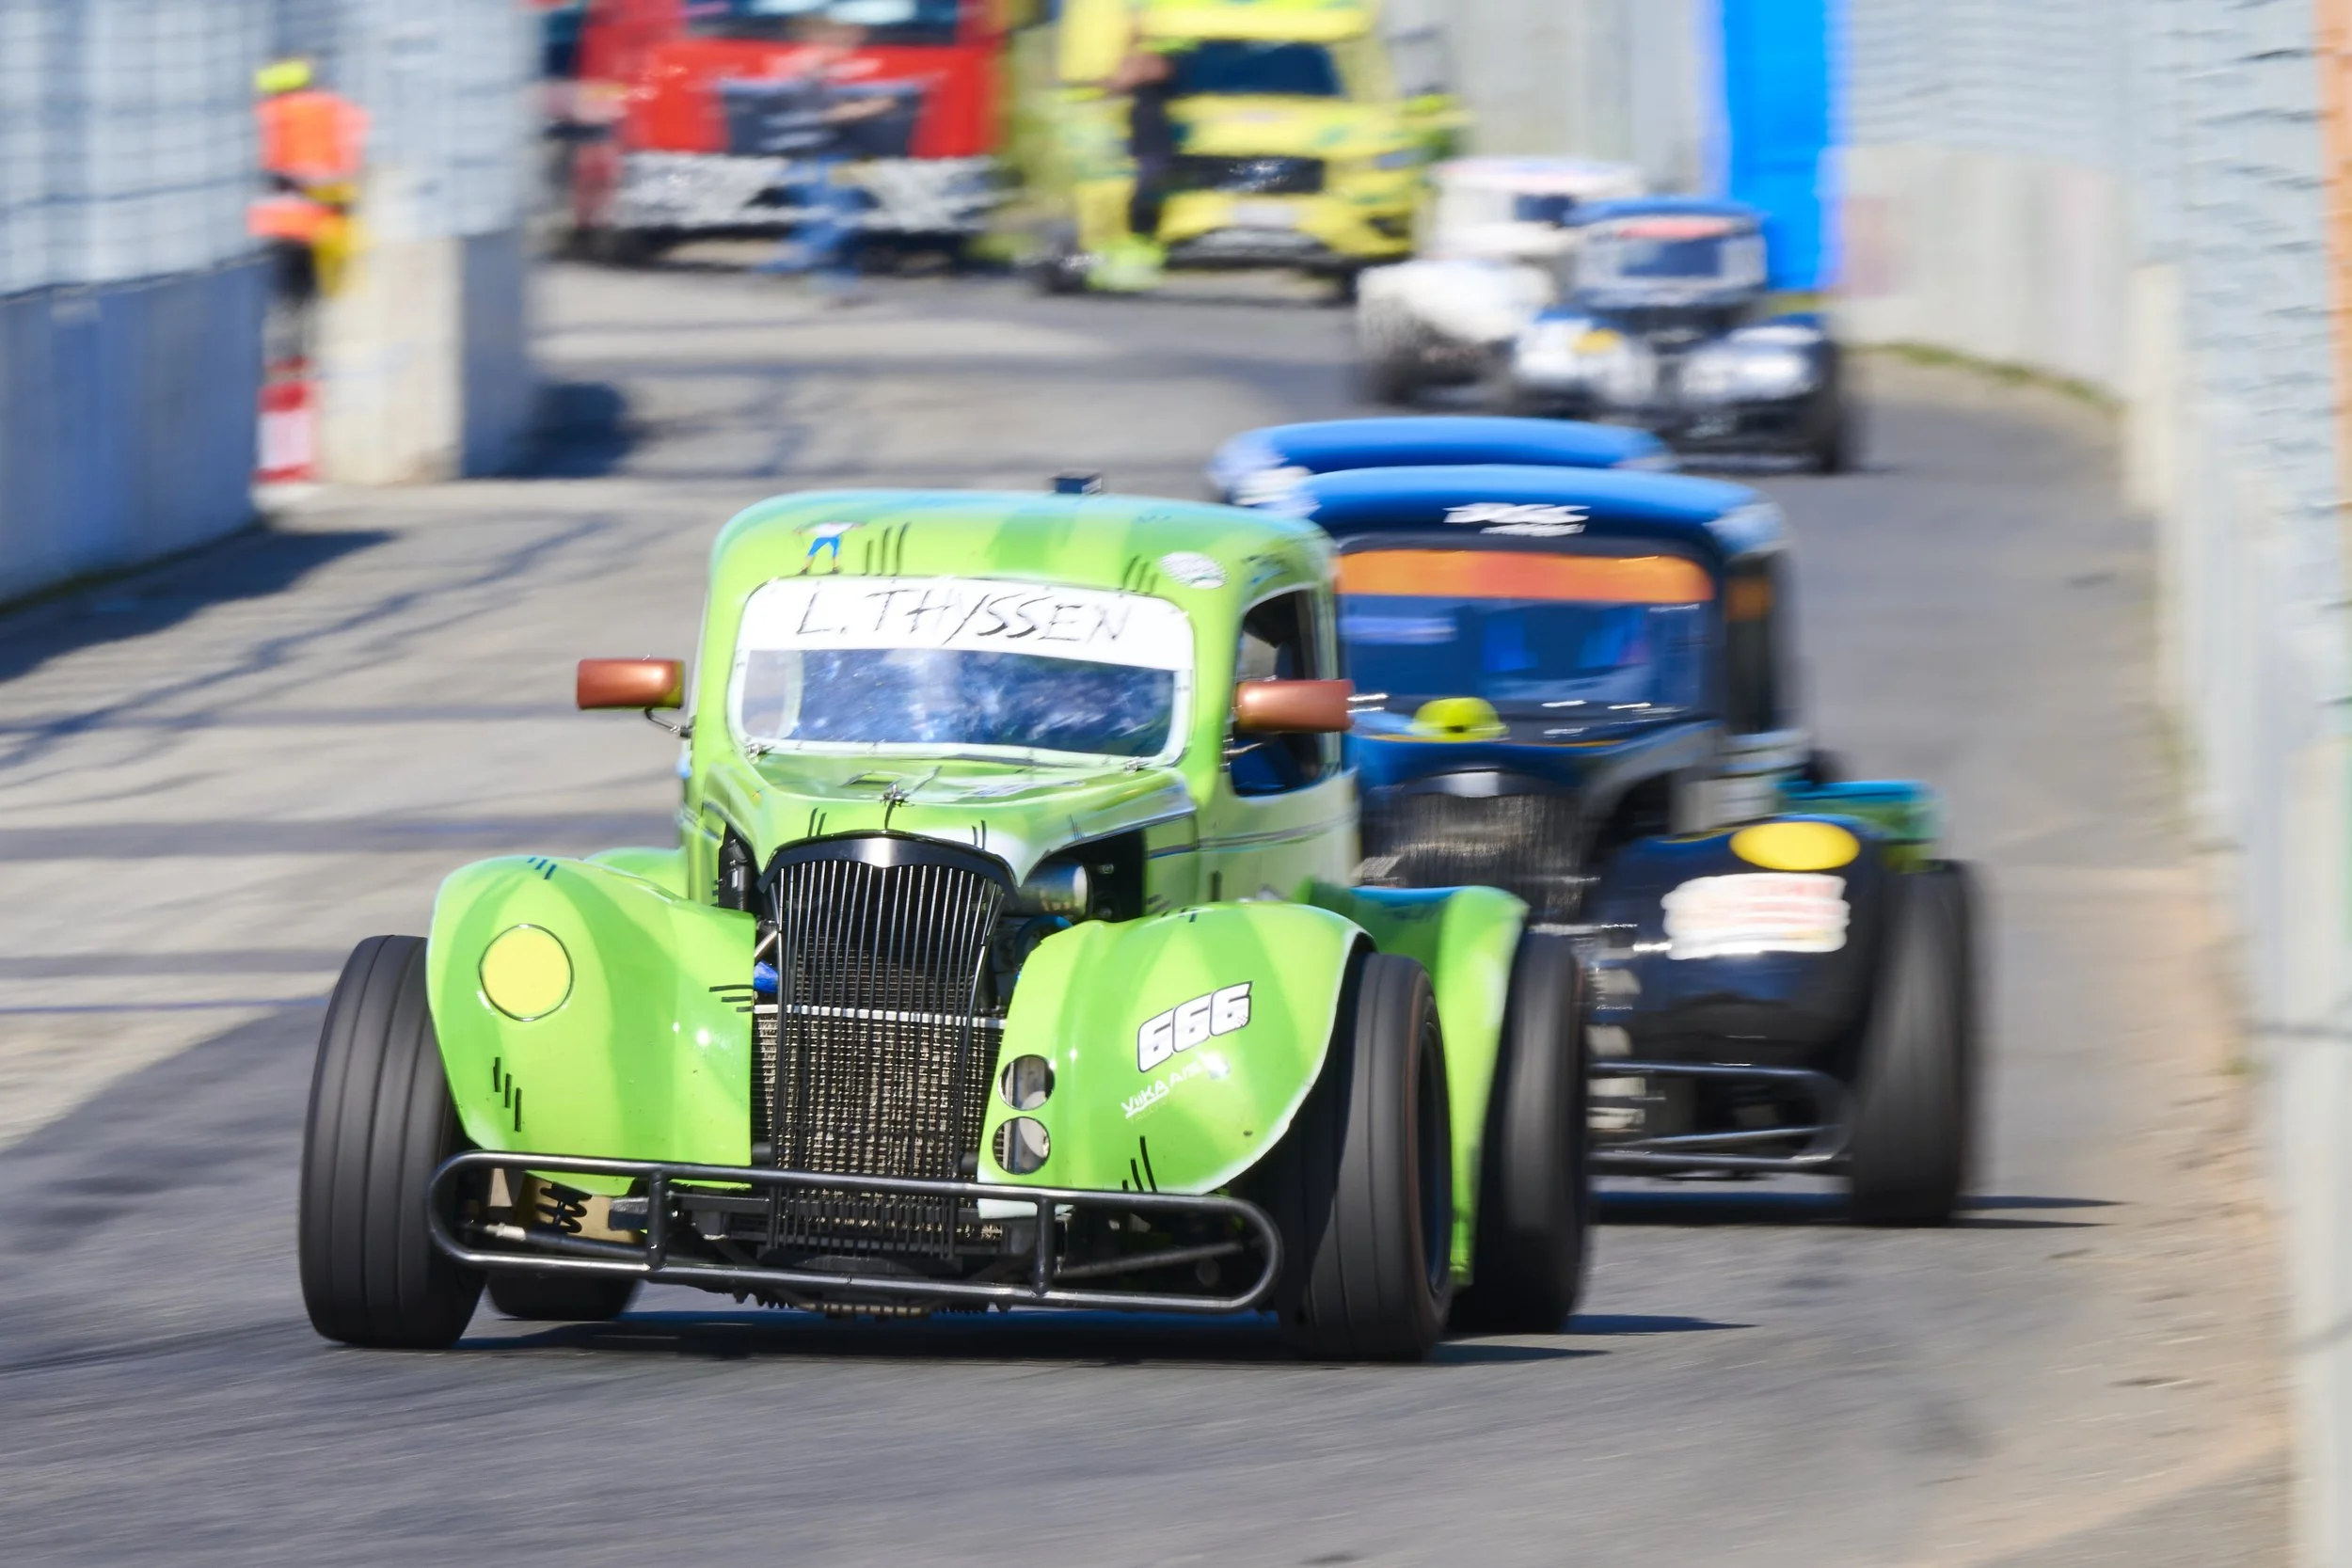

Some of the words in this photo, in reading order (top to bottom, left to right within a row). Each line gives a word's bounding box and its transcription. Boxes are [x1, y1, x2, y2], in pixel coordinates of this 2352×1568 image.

[795, 589, 847, 636] L.
[866, 589, 1134, 645] THYSSEN
[1137, 981, 1252, 1072] 666
